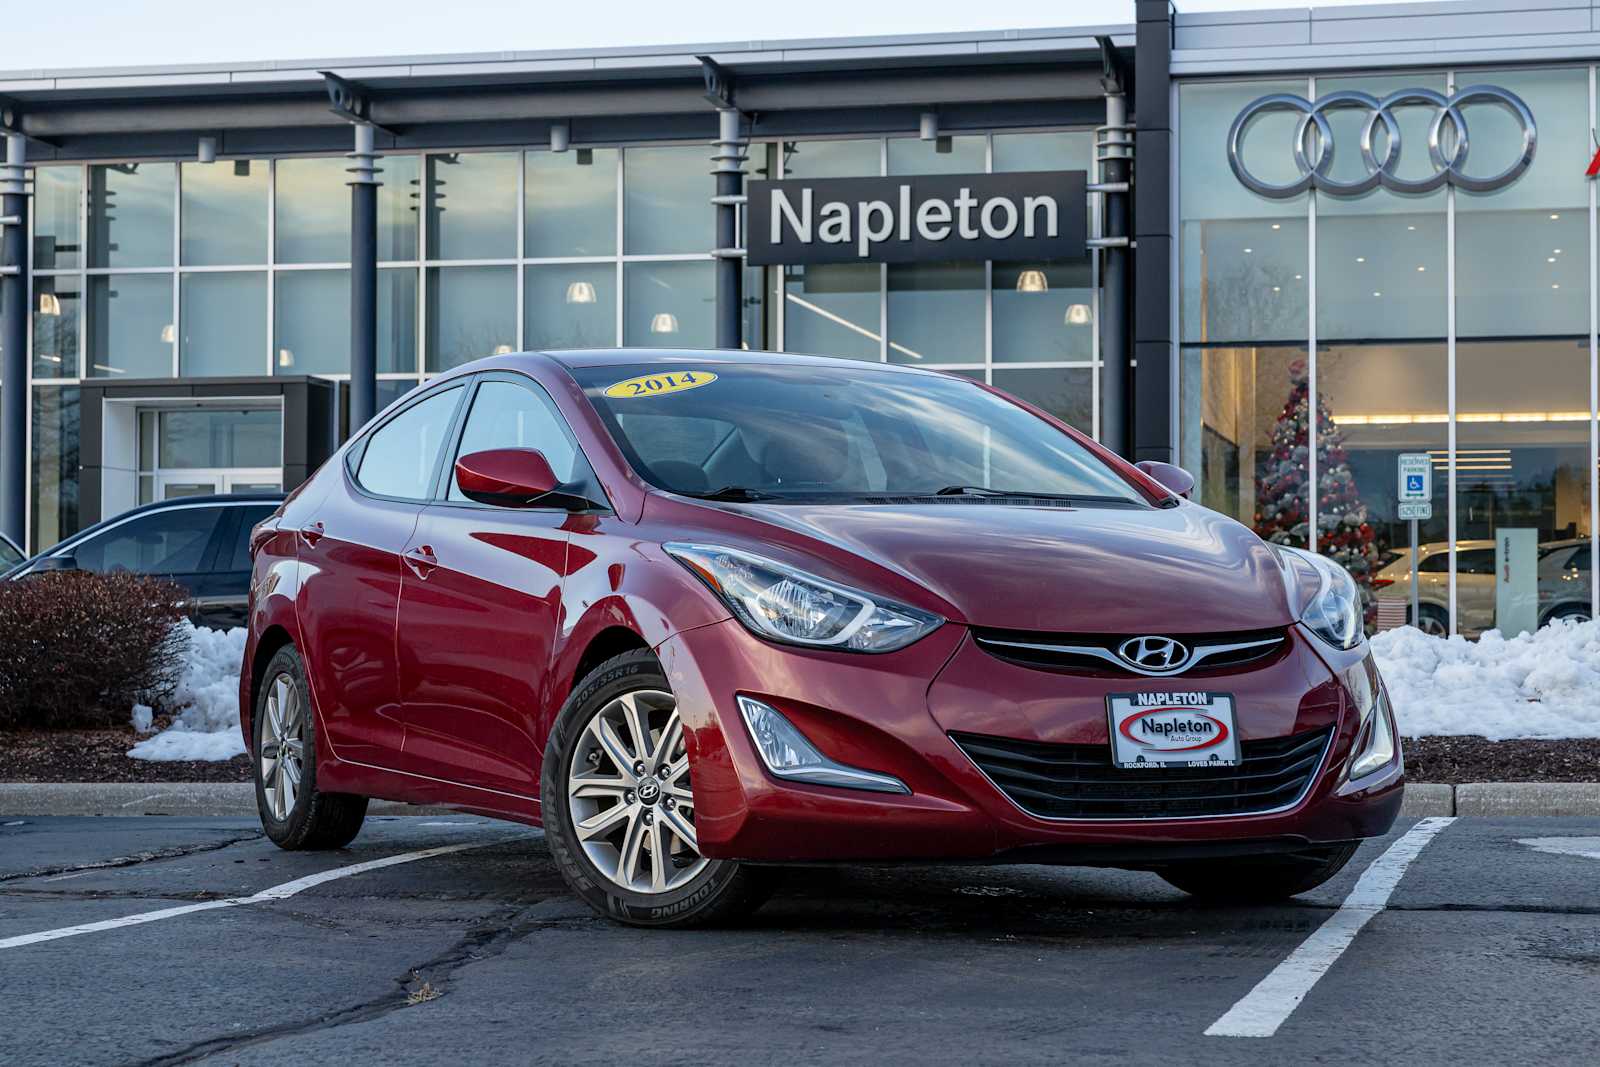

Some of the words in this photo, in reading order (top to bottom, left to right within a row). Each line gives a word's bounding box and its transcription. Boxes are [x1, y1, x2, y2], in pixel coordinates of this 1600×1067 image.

[770, 185, 1058, 257] Napleton
[627, 371, 697, 395] 2014
[1137, 692, 1208, 705] NAPLETON
[1141, 718, 1212, 736] Napleton
[1185, 735, 1202, 743] Group
